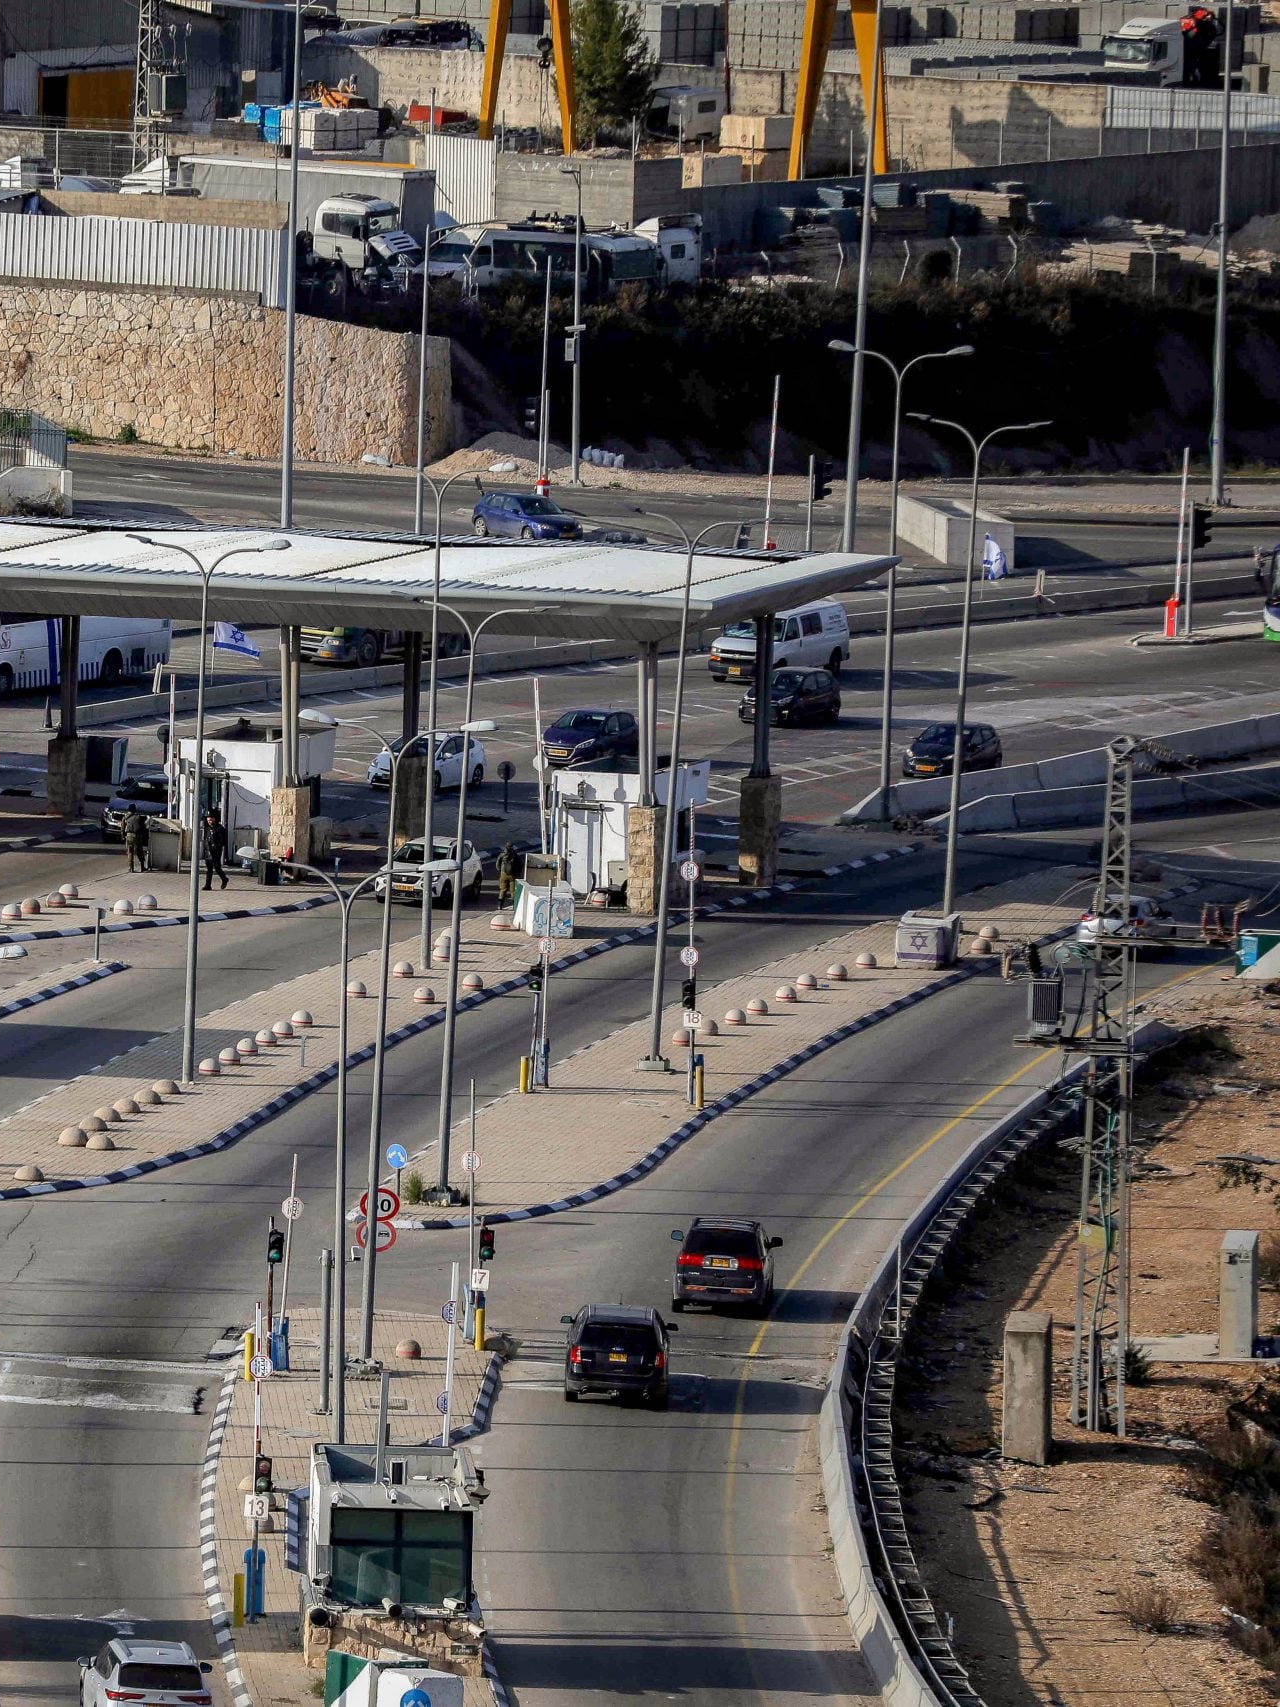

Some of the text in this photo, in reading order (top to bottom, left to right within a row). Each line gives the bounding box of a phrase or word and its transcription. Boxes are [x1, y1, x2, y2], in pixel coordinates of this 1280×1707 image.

[685, 1012, 700, 1024] 18
[473, 1271, 487, 1285] 17
[248, 1499, 265, 1517] 13
